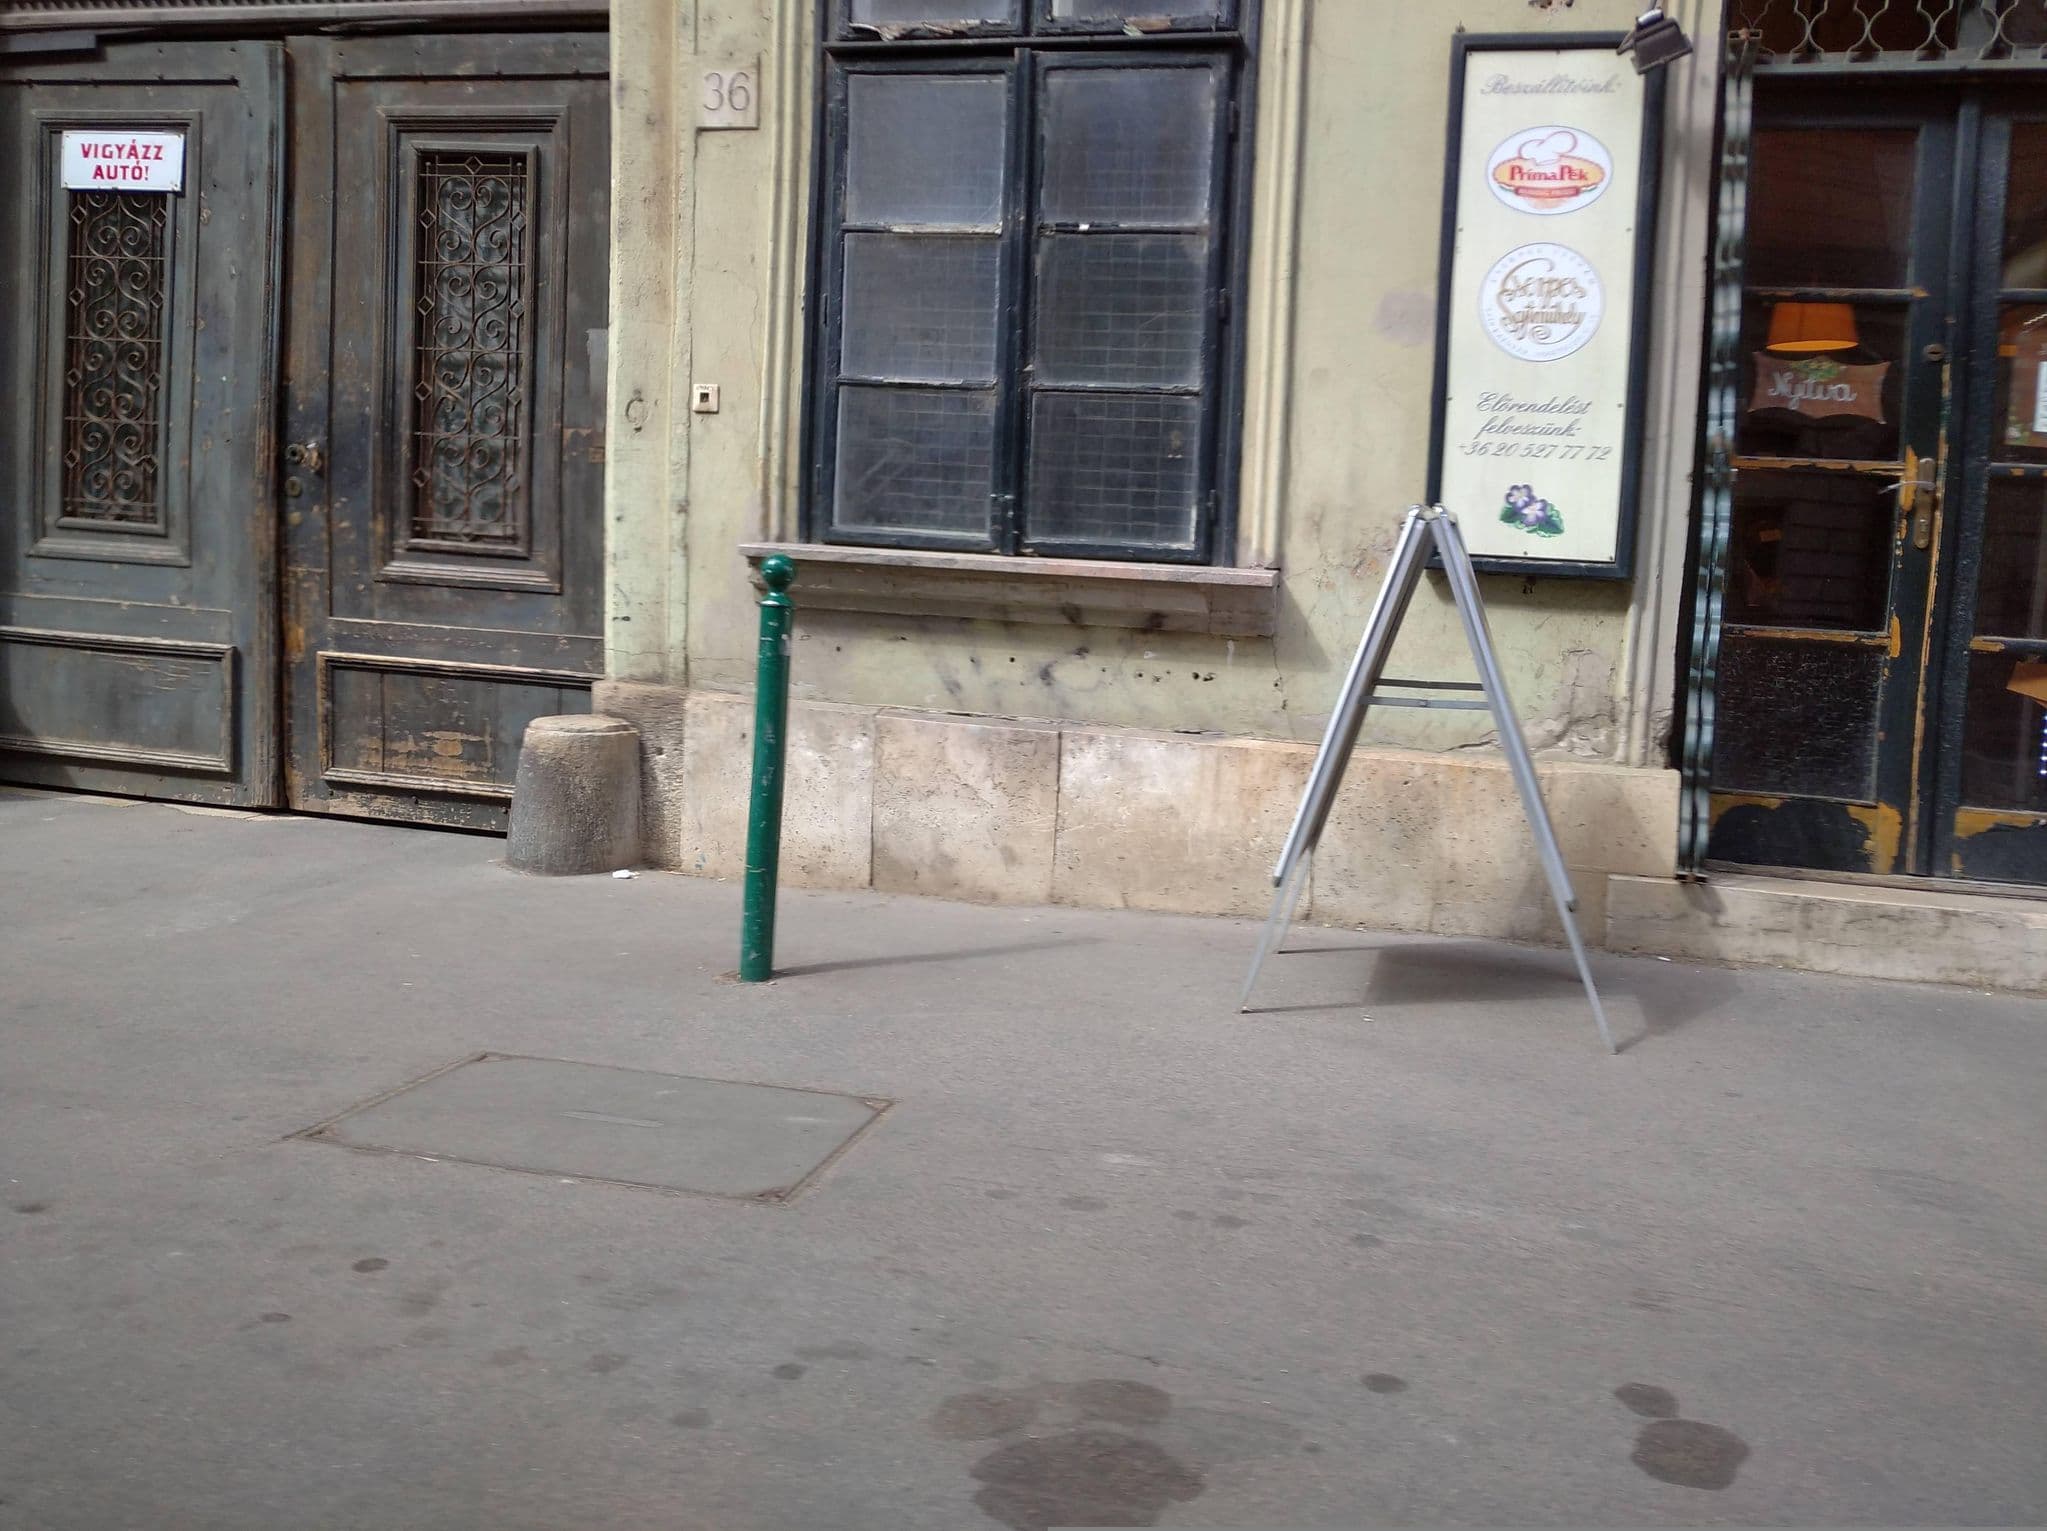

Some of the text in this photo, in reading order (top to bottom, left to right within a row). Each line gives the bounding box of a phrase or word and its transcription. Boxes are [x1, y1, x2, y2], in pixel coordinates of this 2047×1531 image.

[702, 71, 750, 112] 36
[81, 139, 163, 160] VIGYÁZZ
[92, 161, 149, 181] AUTÓ!
